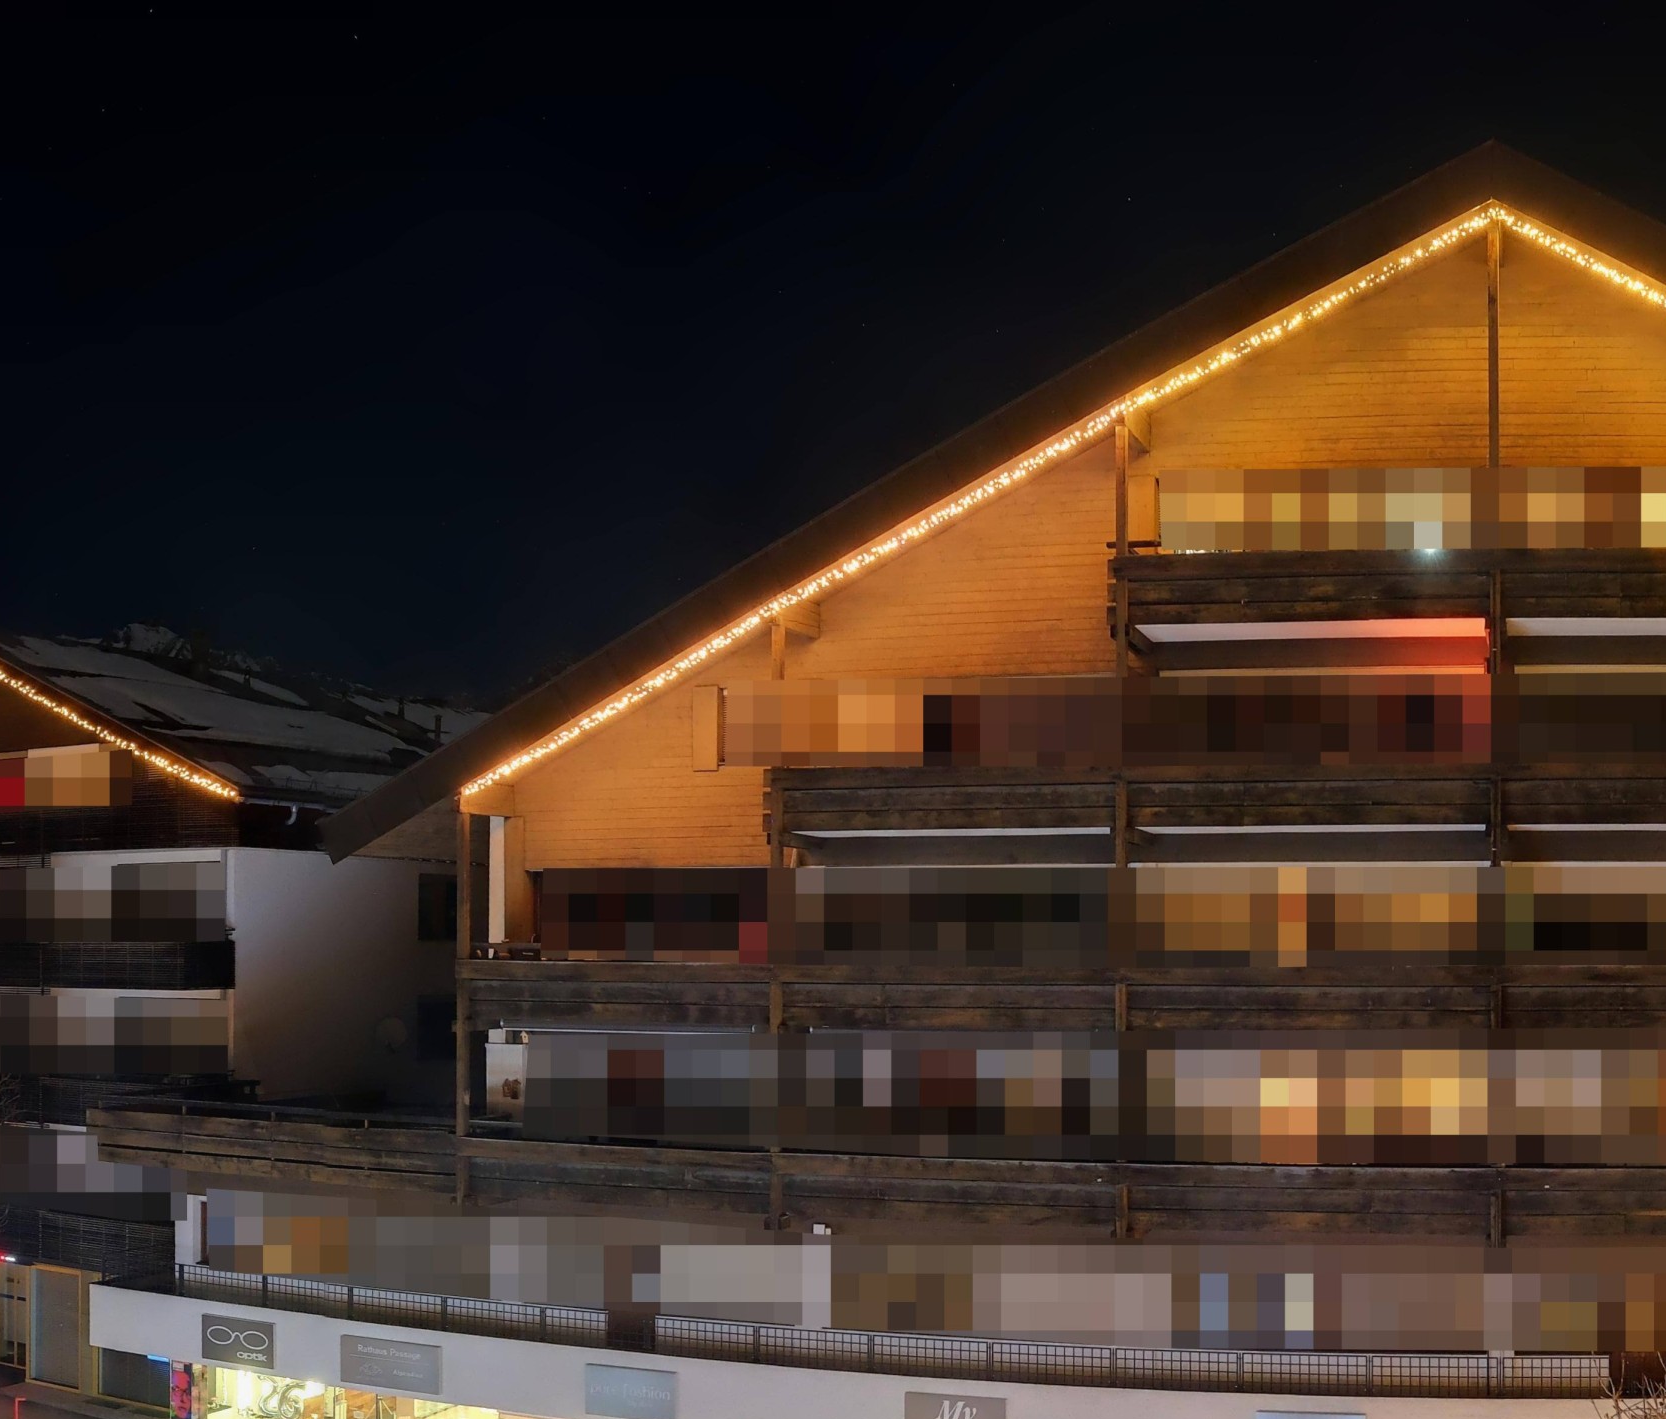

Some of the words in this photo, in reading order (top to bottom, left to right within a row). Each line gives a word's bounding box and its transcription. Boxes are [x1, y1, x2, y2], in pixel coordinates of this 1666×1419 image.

[236, 1351, 268, 1363] optik
[357, 1343, 388, 1356] Rathaus
[390, 1348, 422, 1360] Passage
